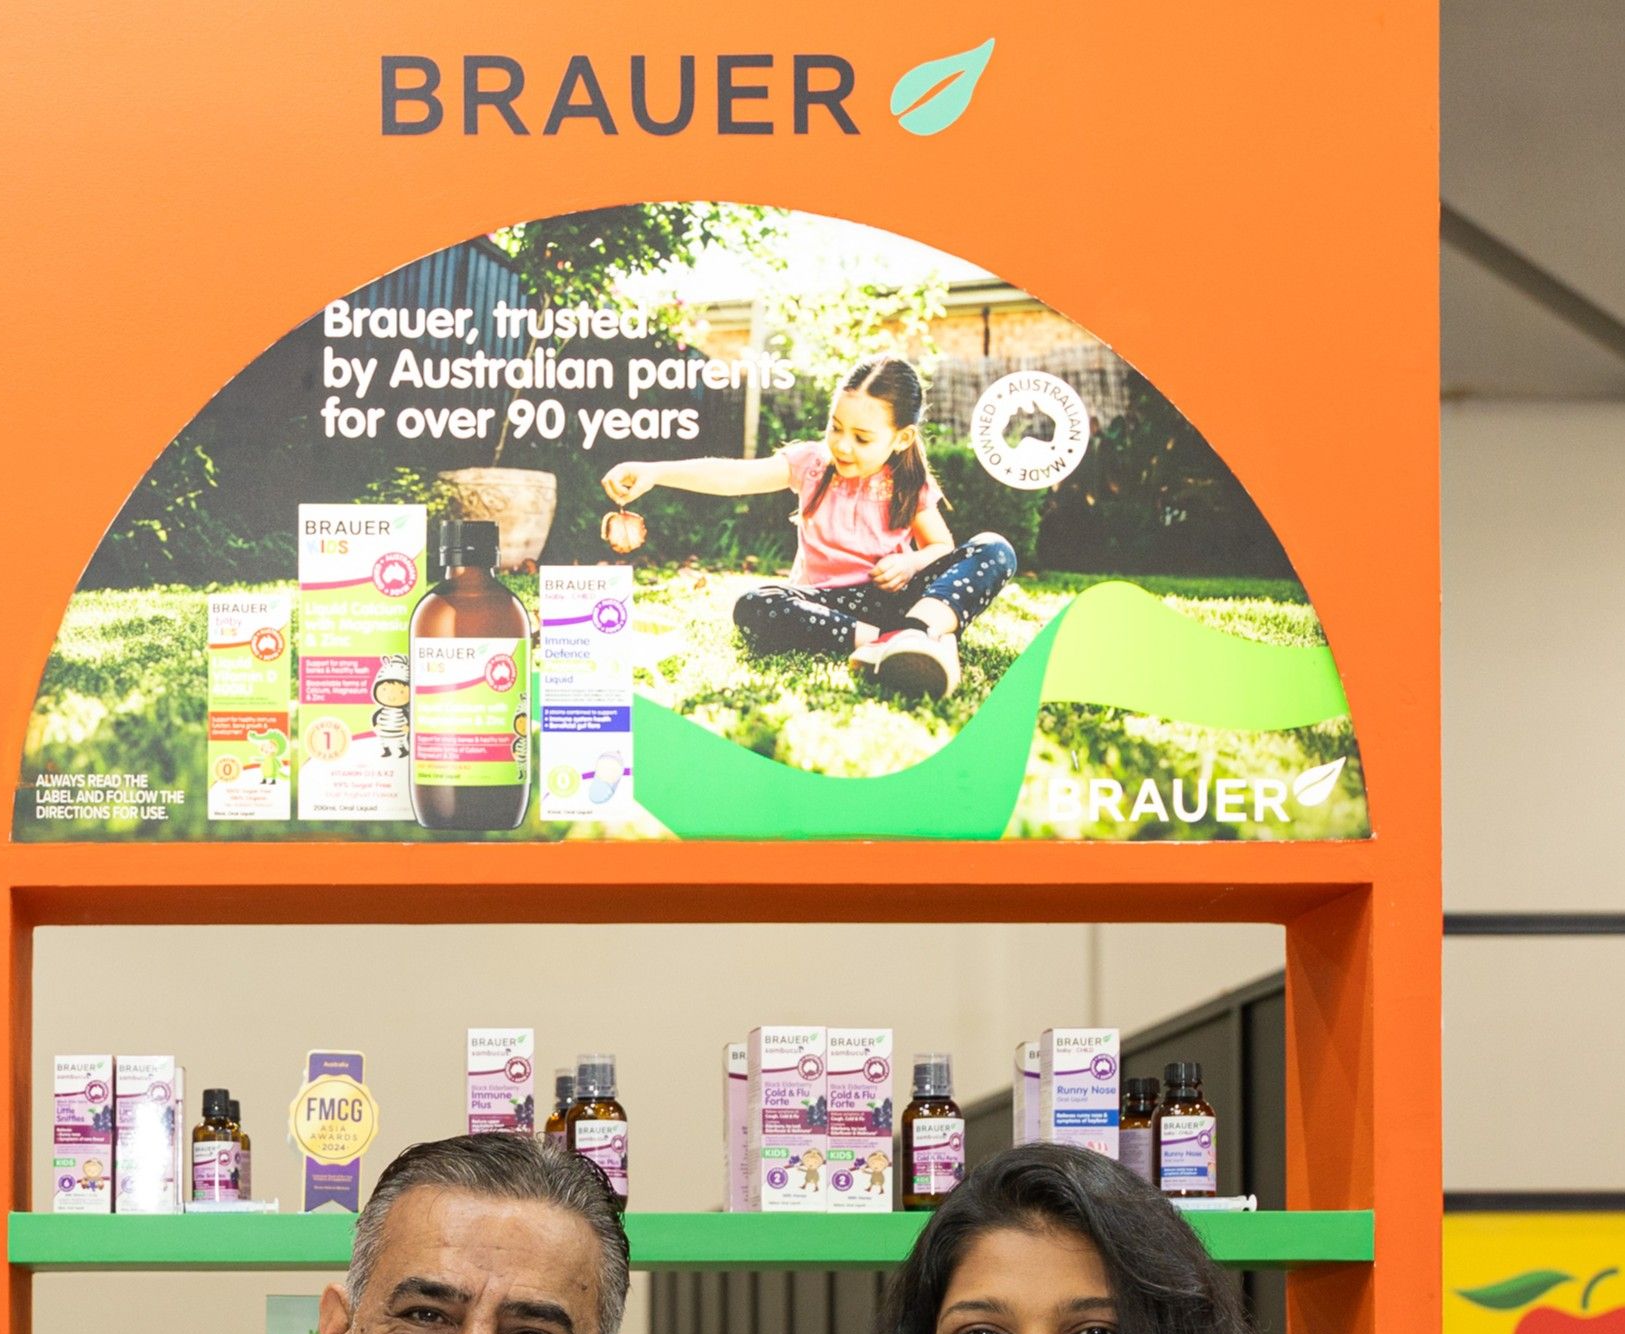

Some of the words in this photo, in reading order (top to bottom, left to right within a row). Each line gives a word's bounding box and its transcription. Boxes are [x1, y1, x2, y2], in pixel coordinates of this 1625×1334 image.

[381, 55, 861, 136] BRAUER
[324, 300, 478, 345] Brauer,
[493, 300, 648, 339] trusted
[323, 346, 377, 398] by
[389, 347, 612, 389] Australian
[629, 350, 795, 398] parents
[1008, 379, 1081, 441] AUSTRALIAN
[321, 396, 384, 438] for
[396, 406, 496, 438] over
[508, 399, 565, 439] 90
[577, 408, 699, 449] years
[979, 403, 1001, 466] OWNED
[1019, 457, 1066, 481] MADE
[305, 520, 390, 535] BRAUER
[545, 579, 606, 591] BRAUER
[213, 604, 267, 614] BRAUER
[36, 774, 85, 787] ALWAYS
[88, 774, 121, 787] READ
[124, 774, 148, 787] THE
[36, 790, 74, 803] LABEL
[76, 790, 104, 803] AND
[106, 790, 158, 804] FOLLOW
[160, 790, 184, 804] THE
[1048, 778, 1291, 822] BRAUER
[36, 806, 110, 819] DIRECTIONS
[113, 806, 138, 819] FOR
[141, 806, 169, 819] USE.
[471, 1038, 517, 1047] BRAUER
[765, 1036, 809, 1045] BRAUER
[830, 1038, 875, 1047] BRAUER
[1056, 1037, 1102, 1047] BRAUER
[471, 1091, 512, 1099] Immune
[1057, 1085, 1088, 1096] Runny
[1091, 1085, 1116, 1095] Nose
[57, 1107, 75, 1115] Little
[306, 1097, 363, 1122] FMCG
[471, 1100, 492, 1109] Plus
[310, 1133, 358, 1141] AWARDS
